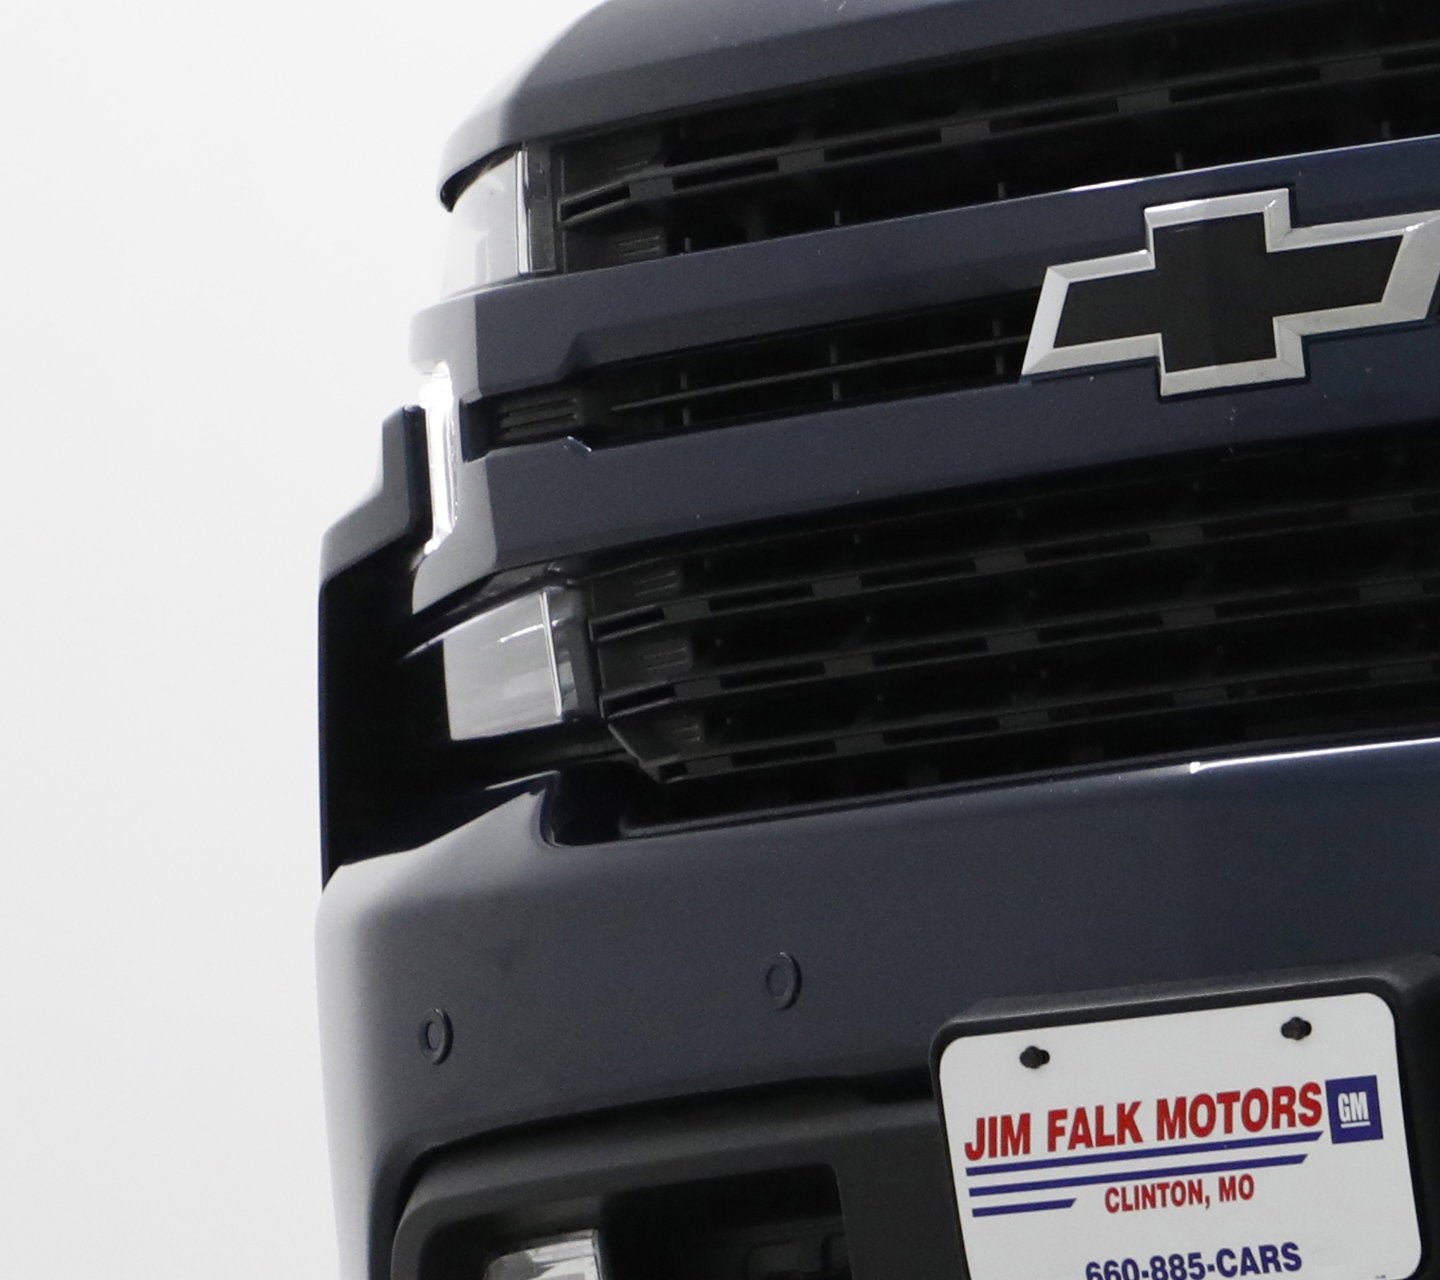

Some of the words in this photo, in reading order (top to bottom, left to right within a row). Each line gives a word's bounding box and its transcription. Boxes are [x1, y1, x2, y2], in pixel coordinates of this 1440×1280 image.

[964, 1113, 1031, 1161] JIM
[1047, 1101, 1143, 1152] FALK
[1156, 1082, 1323, 1141] MOTORS
[1337, 1091, 1370, 1123] GM
[1105, 1179, 1210, 1213] CLINTON,
[1218, 1173, 1254, 1201] MO
